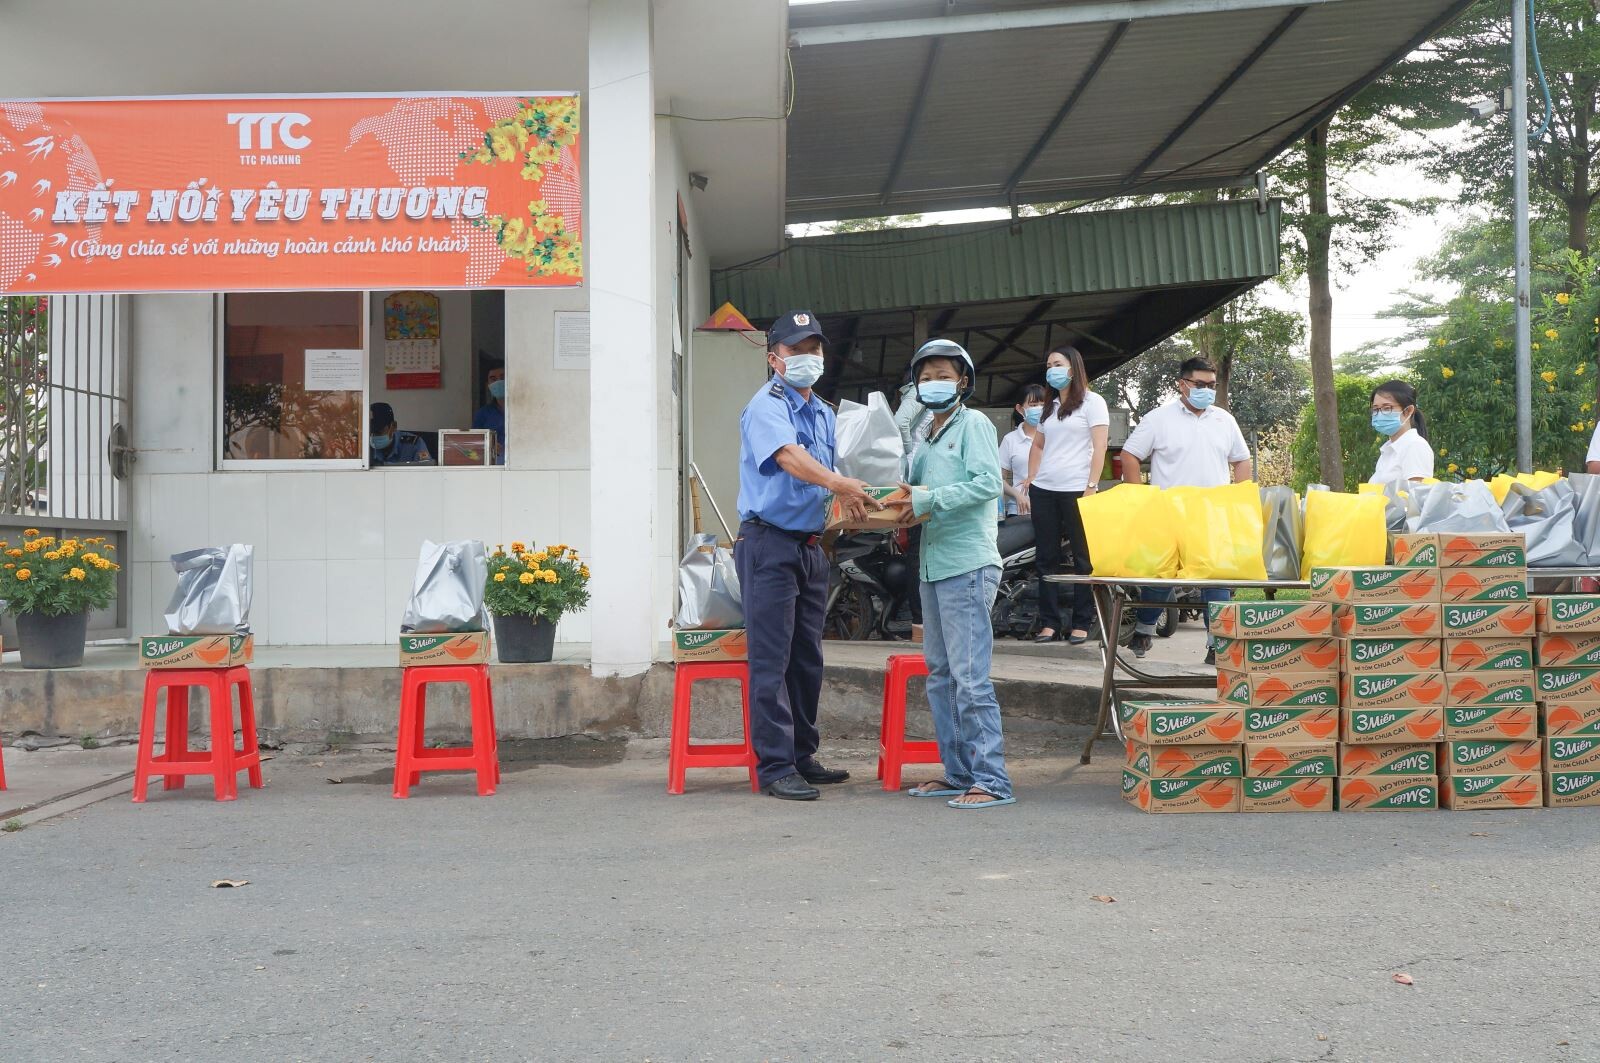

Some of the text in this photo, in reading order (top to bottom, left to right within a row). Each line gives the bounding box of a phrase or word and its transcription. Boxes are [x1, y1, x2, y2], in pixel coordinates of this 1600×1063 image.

[227, 112, 312, 150] TTC
[240, 154, 301, 165] TTC PACKING
[52, 178, 139, 222] KẾT
[230, 180, 312, 222] YÊU
[70, 236, 469, 259] (Cùng chia sẻ với những hoàn cảnh khó khăn)
[1283, 621, 1295, 630] CAY
[1486, 622, 1498, 631] CAY
[1577, 641, 1588, 649] CAY
[182, 652, 194, 660] CAY
[1289, 655, 1302, 664] CAY
[1392, 656, 1404, 664] CAY
[1580, 684, 1592, 694] CAY
[1395, 691, 1407, 699] CAY
[1584, 710, 1595, 719] CAY
[1194, 728, 1206, 737] CAY
[1287, 725, 1300, 734] CAY
[1393, 726, 1406, 735] CAY
[1380, 750, 1392, 759] CAY
[1590, 754, 1600, 762] CA
[1494, 758, 1506, 766] CAY
[1380, 783, 1392, 792] CAY
[1592, 788, 1600, 796] CA
